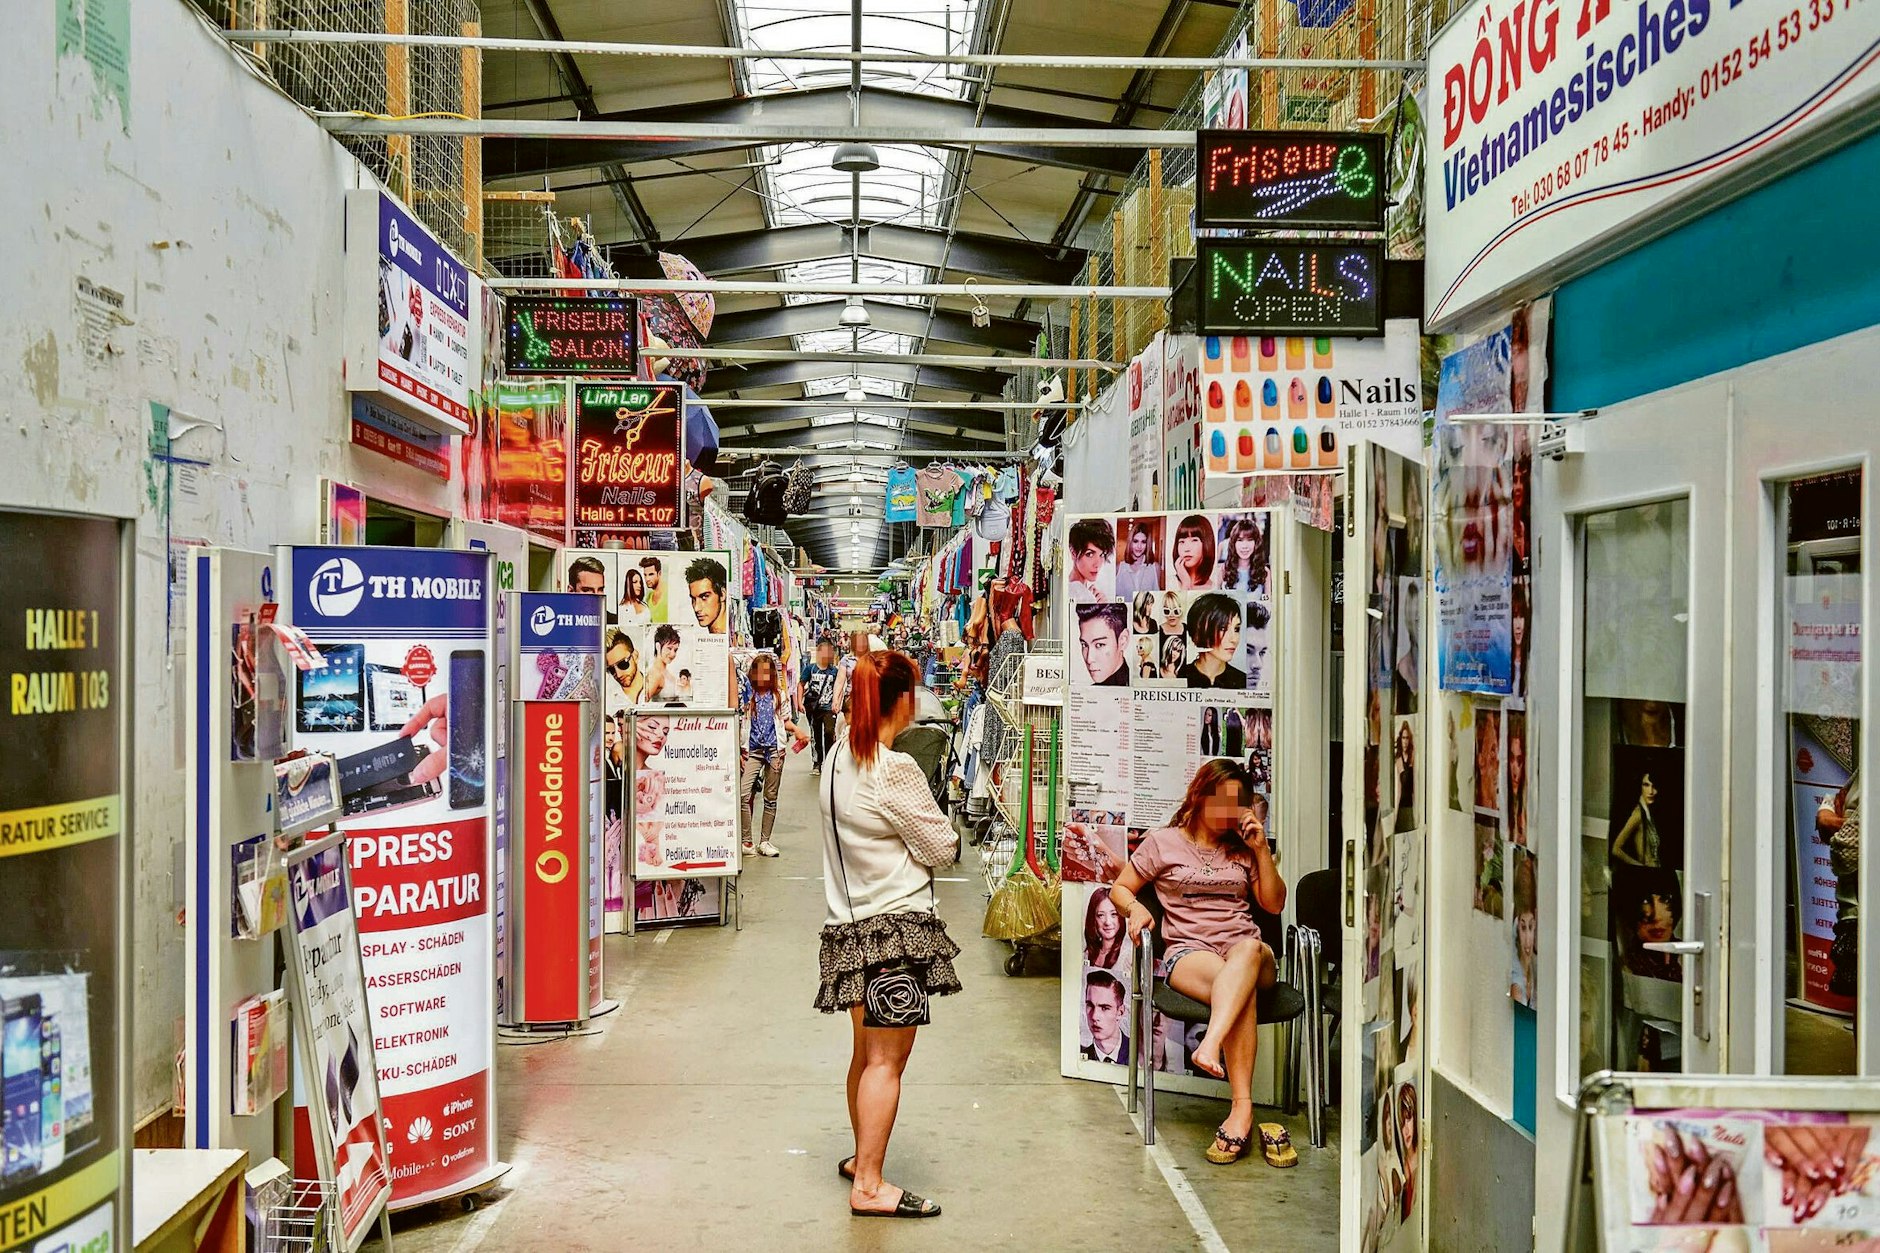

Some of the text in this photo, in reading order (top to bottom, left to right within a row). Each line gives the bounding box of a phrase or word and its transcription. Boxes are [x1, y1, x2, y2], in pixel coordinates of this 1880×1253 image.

[1443, 0, 1709, 212] Vietnamesisches
[1511, 193, 1530, 219] Tel:
[1533, 175, 1553, 207] 030
[1556, 161, 1571, 192] 68
[1574, 149, 1589, 184] 07
[1593, 140, 1608, 170] 78
[1613, 122, 1630, 161] 45
[1642, 84, 1695, 138] Handy:
[1700, 51, 1742, 100] 0152
[1749, 38, 1771, 70] 54
[1777, 9, 1801, 50] 53
[1209, 144, 1338, 192] Friseur
[1212, 252, 1369, 302] NAILS
[1233, 294, 1343, 323] OPEN
[533, 310, 626, 332] FRISEUR
[550, 338, 624, 359] SALON
[585, 390, 649, 406] Linh Lan
[1339, 376, 1416, 406] Nails
[1339, 408, 1362, 419] Halle
[1364, 408, 1369, 418] 1
[1377, 408, 1401, 417] Raum
[1404, 406, 1419, 416] 106
[1339, 417, 1420, 430] Tel. 0152 37843666
[580, 438, 675, 485] Friseur
[600, 485, 657, 506] Nails
[581, 507, 613, 522] Halle
[618, 508, 626, 521] 1
[368, 575, 482, 601] TH MOBILE
[26, 608, 99, 650] HALLE 1
[557, 614, 574, 626] TH
[1036, 668, 1064, 680] BES
[11, 670, 109, 715] RAUM 103
[1133, 690, 1203, 703] PREISLISTE
[674, 716, 729, 731] Linh Lan
[664, 744, 718, 762] Neumodellage
[539, 712, 564, 843] vodafone
[665, 801, 696, 815] Auffüllen
[60, 807, 109, 837] SERVICE
[665, 846, 695, 861] Pediküre
[706, 845, 729, 859] Maniküre
[418, 930, 465, 951] SCHÄDEN
[380, 995, 447, 1019] SOFTWARE
[375, 1025, 450, 1051] ELEKTRONIK
[450, 1098, 474, 1115] iPhone
[443, 1117, 478, 1141] SONY
[0, 1196, 47, 1246] TEN
